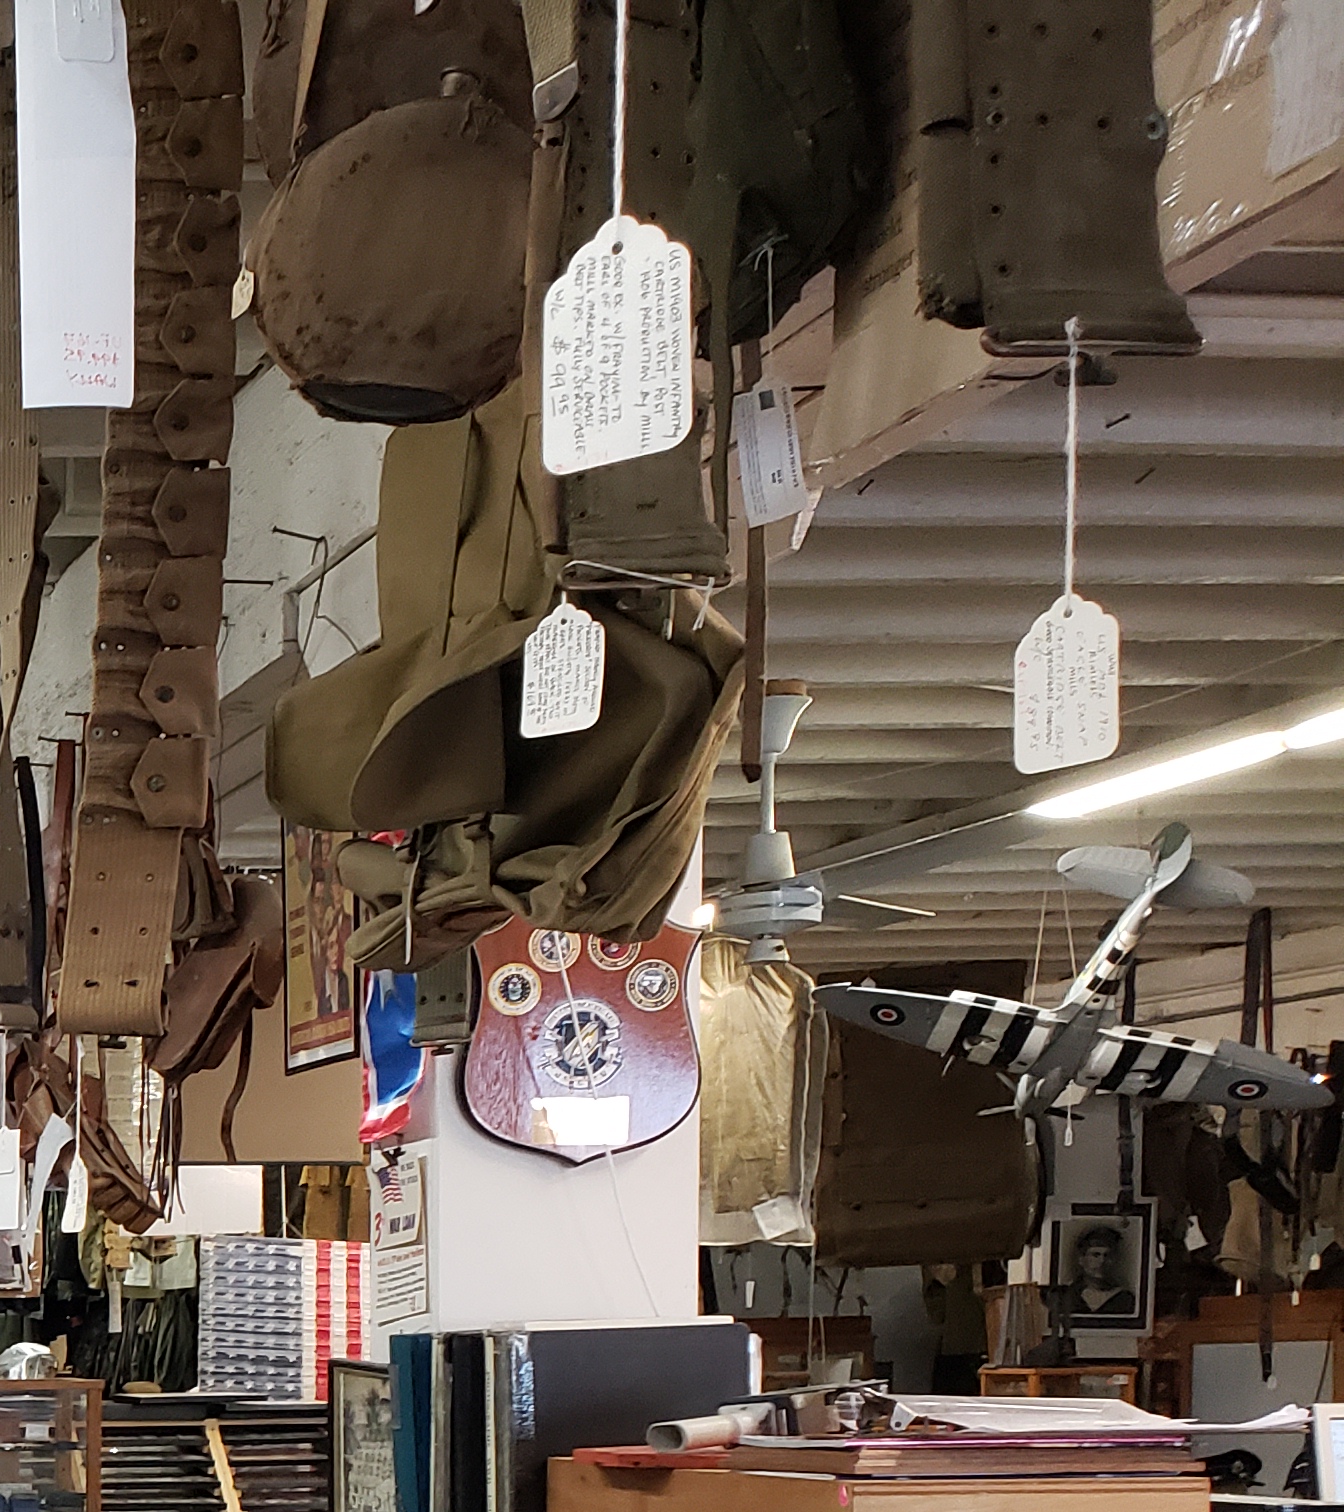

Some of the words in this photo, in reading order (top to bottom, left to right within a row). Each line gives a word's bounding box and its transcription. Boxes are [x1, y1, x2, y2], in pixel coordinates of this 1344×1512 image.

[613, 256, 626, 288] GOOD
[669, 248, 682, 271] US
[670, 328, 682, 372] WOVEN
[664, 378, 683, 439] INFANTRY
